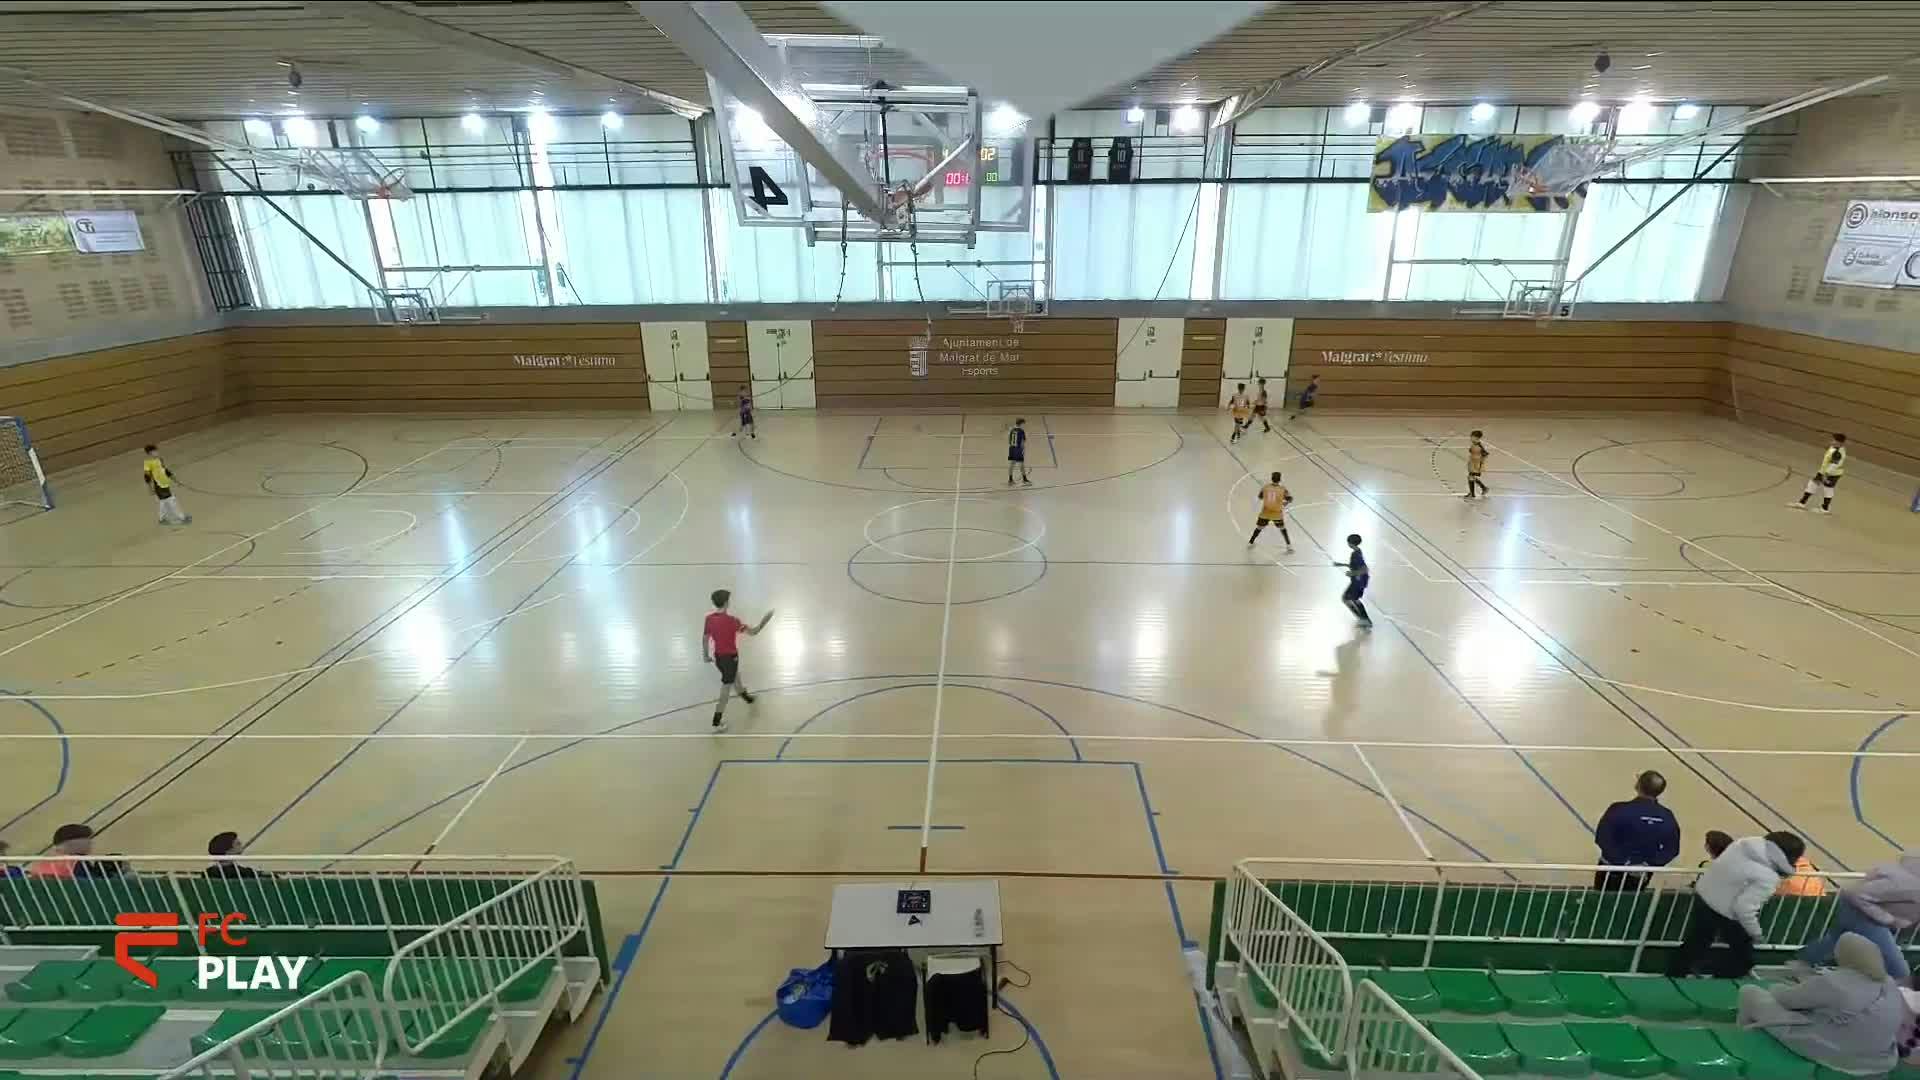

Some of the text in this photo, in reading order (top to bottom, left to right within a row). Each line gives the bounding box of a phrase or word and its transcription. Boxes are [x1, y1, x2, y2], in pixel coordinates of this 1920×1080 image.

[1560, 305, 1570, 317] 5
[939, 351, 980, 364] Malgrat
[982, 351, 996, 362] de
